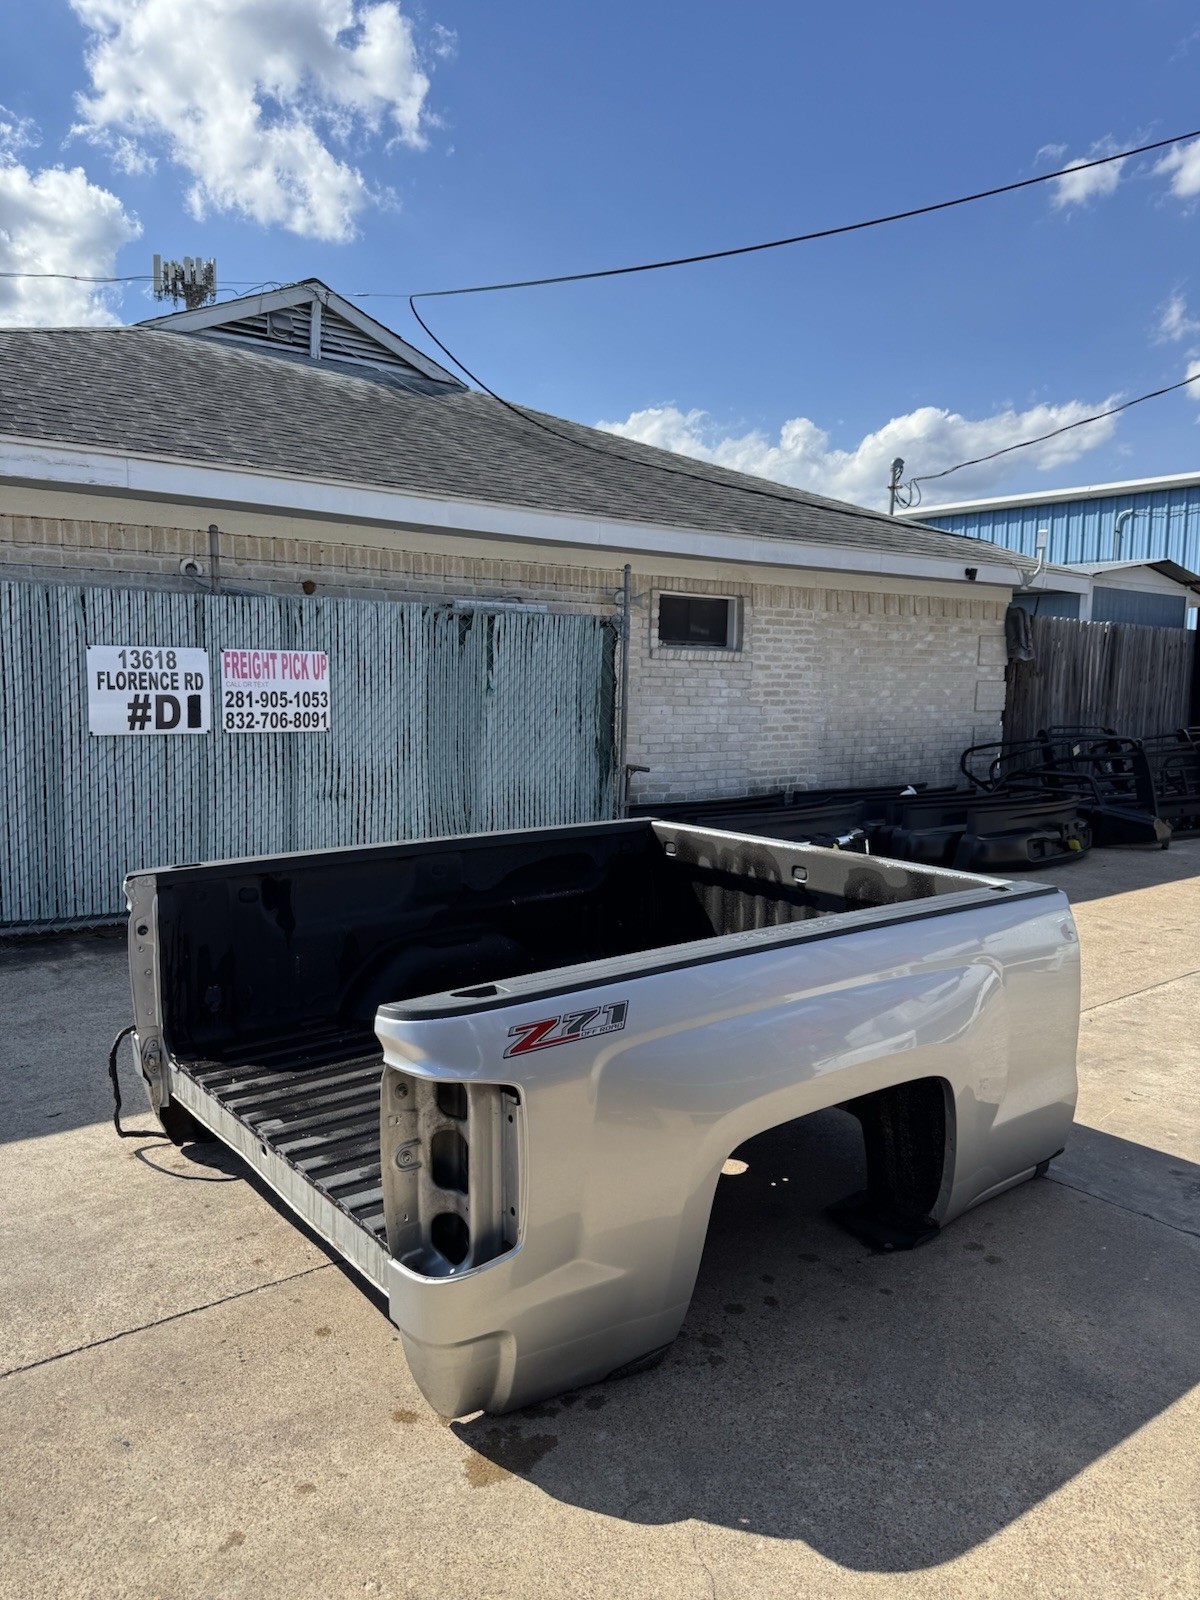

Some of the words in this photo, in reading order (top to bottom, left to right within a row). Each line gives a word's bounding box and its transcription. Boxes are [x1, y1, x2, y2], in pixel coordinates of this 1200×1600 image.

[118, 650, 177, 669] 13618
[224, 651, 277, 679] FREIGHT
[281, 653, 309, 680] PICK
[313, 654, 327, 680] UP
[97, 671, 179, 690] FLORENCE
[184, 672, 204, 690] RD
[225, 691, 328, 708] 281-905-1053
[226, 711, 328, 729] 832-706-8091
[503, 999, 629, 1059] Z71
[581, 1029, 598, 1037] OFF
[599, 1022, 624, 1033] ROAD
